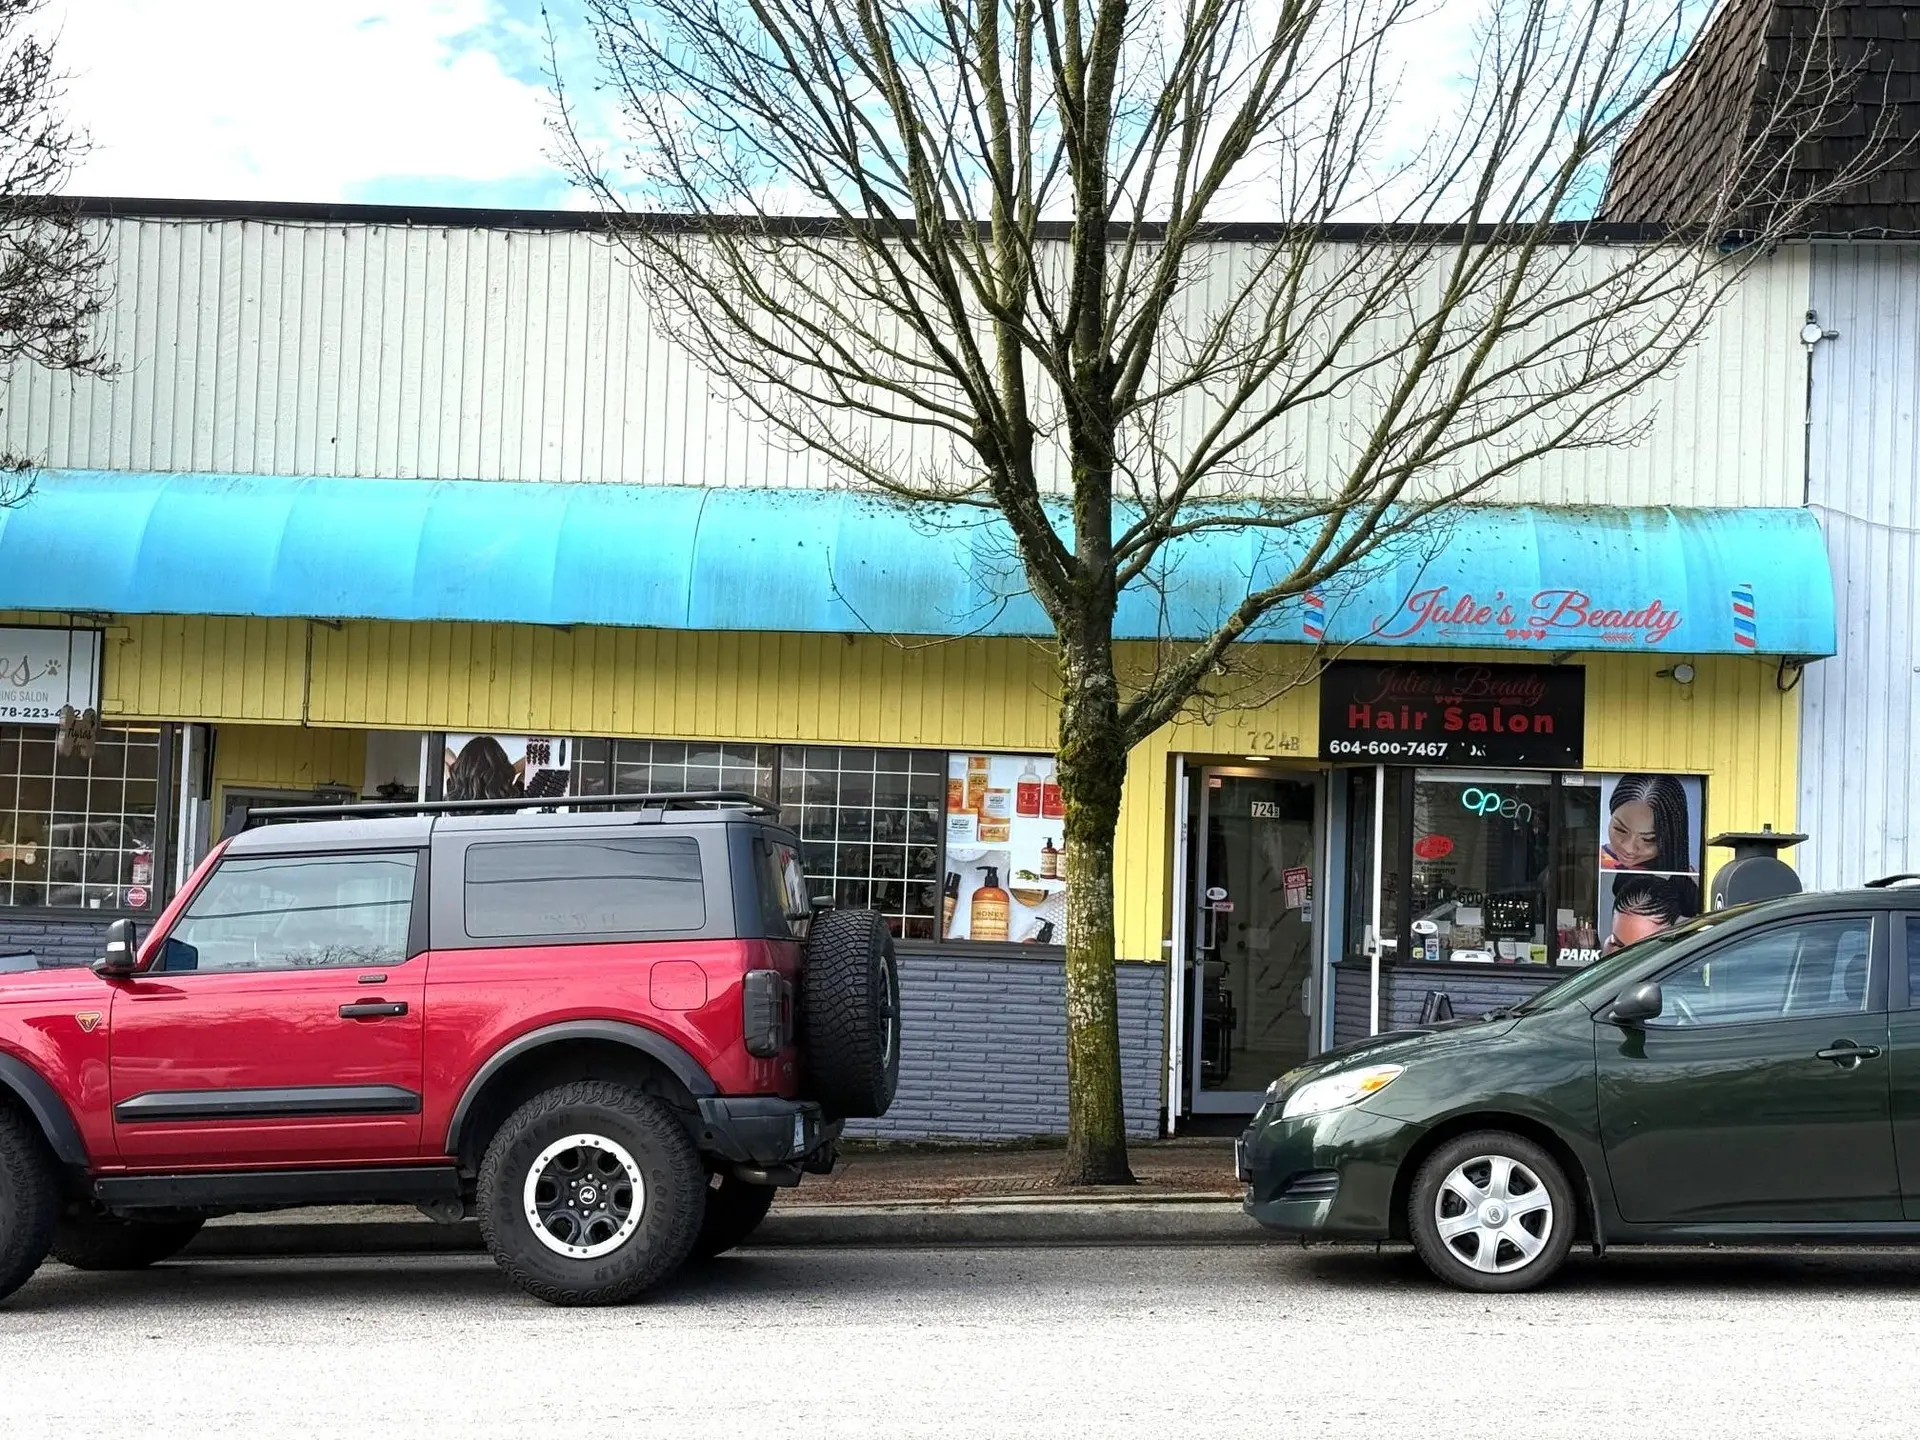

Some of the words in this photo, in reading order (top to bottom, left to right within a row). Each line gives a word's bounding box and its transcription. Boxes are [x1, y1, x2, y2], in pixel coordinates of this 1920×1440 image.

[1372, 586, 1517, 638] Julie's
[1528, 590, 1683, 643] Beauty
[1353, 664, 1444, 703] Julie's
[1453, 665, 1549, 707] Beauty
[0, 690, 16, 702] ING
[19, 691, 49, 703] SALON
[1348, 704, 1428, 730] Hair
[1444, 706, 1554, 734] Salon
[1247, 731, 1300, 751] 724B
[1329, 739, 1449, 757] 604-600-7467
[1287, 873, 1306, 883] OPEN
[1421, 866, 1456, 875] Shaving
[975, 910, 1005, 918] HONEY
[1559, 948, 1602, 961] PARK
[593, 1168, 668, 1282] GOODYEAR
